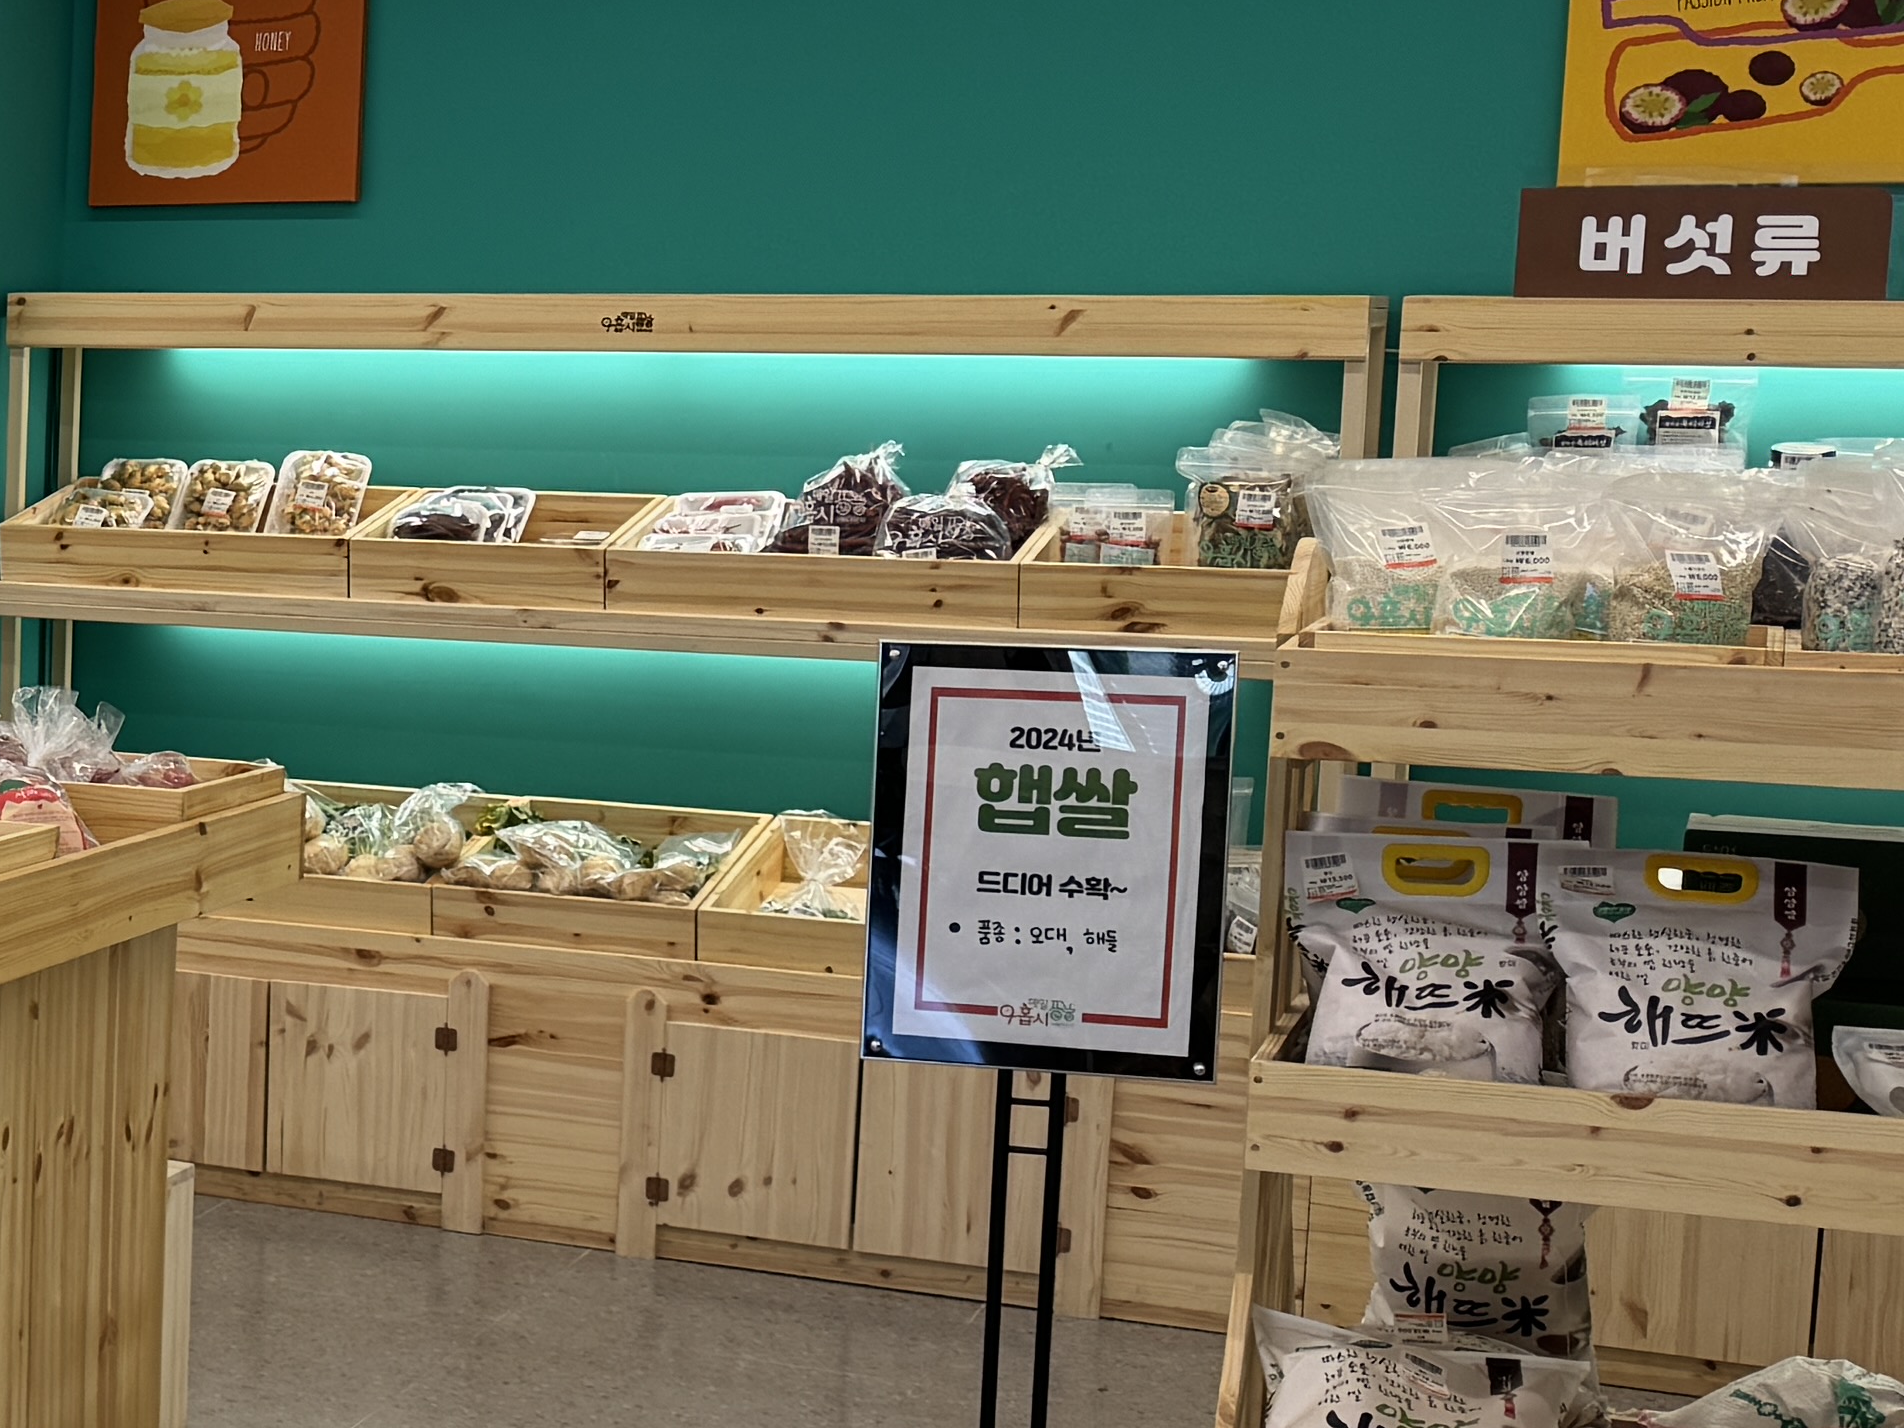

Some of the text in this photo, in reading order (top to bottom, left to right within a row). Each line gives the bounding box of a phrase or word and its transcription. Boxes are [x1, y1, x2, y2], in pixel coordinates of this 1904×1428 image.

[254, 30, 292, 53] HONEY
[1579, 214, 1821, 276] 버섯류
[1009, 726, 1102, 754] 2024년
[974, 762, 1139, 840] 햅쌀
[976, 870, 1053, 898] 드디어
[977, 919, 1007, 947] 품종
[1083, 928, 1119, 954] 해들
[1399, 949, 1485, 980] 양양
[1662, 974, 1751, 1008] 양양
[1437, 1260, 1522, 1294] 양양
